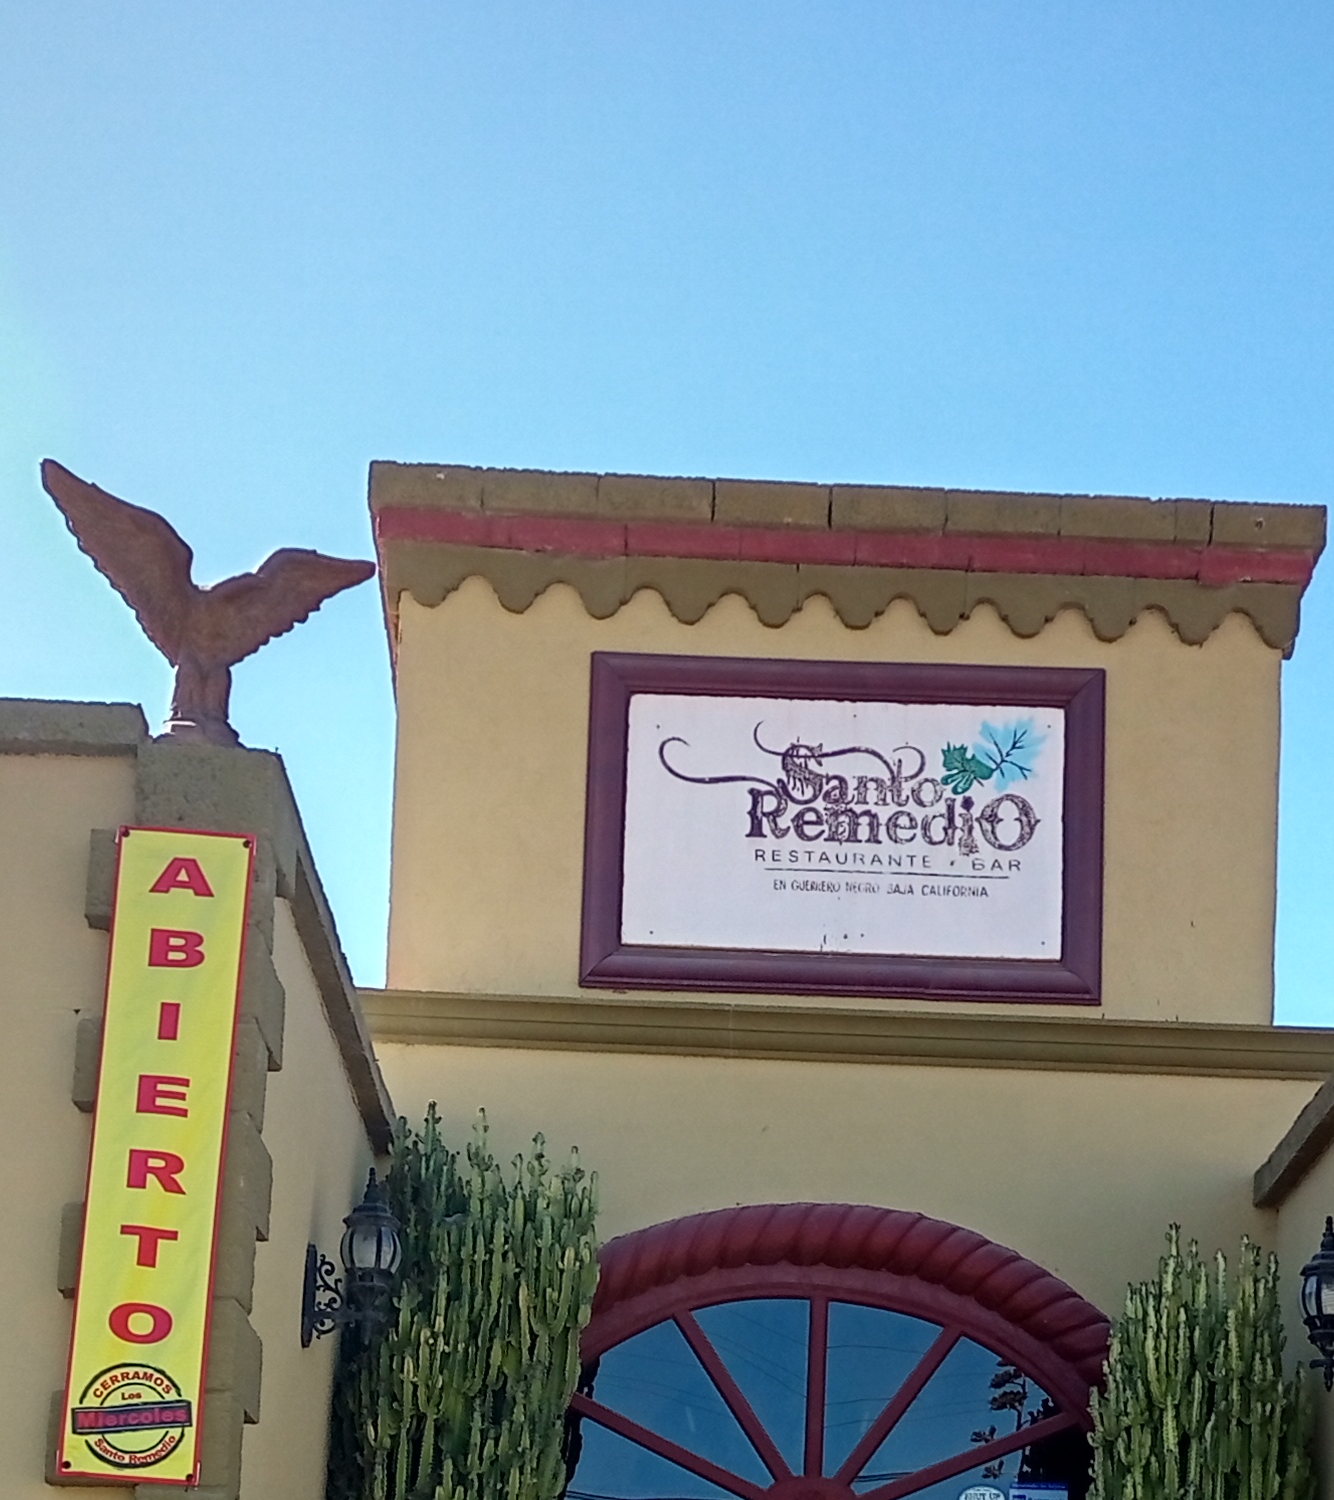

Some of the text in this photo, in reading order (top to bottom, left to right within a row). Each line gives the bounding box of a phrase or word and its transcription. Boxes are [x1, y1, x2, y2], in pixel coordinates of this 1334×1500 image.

[754, 849, 1022, 872] RESTAURANTE BAR
[773, 879, 787, 891] EN
[791, 880, 841, 893] GUERRERO
[921, 884, 990, 898] CALIFORNIA
[108, 856, 215, 1345] ABIERTO
[93, 1370, 173, 1399] CERRAMOS
[121, 1391, 142, 1401] Los
[77, 1408, 188, 1428] Miercoles
[94, 1435, 177, 1465] Santo Remedio
